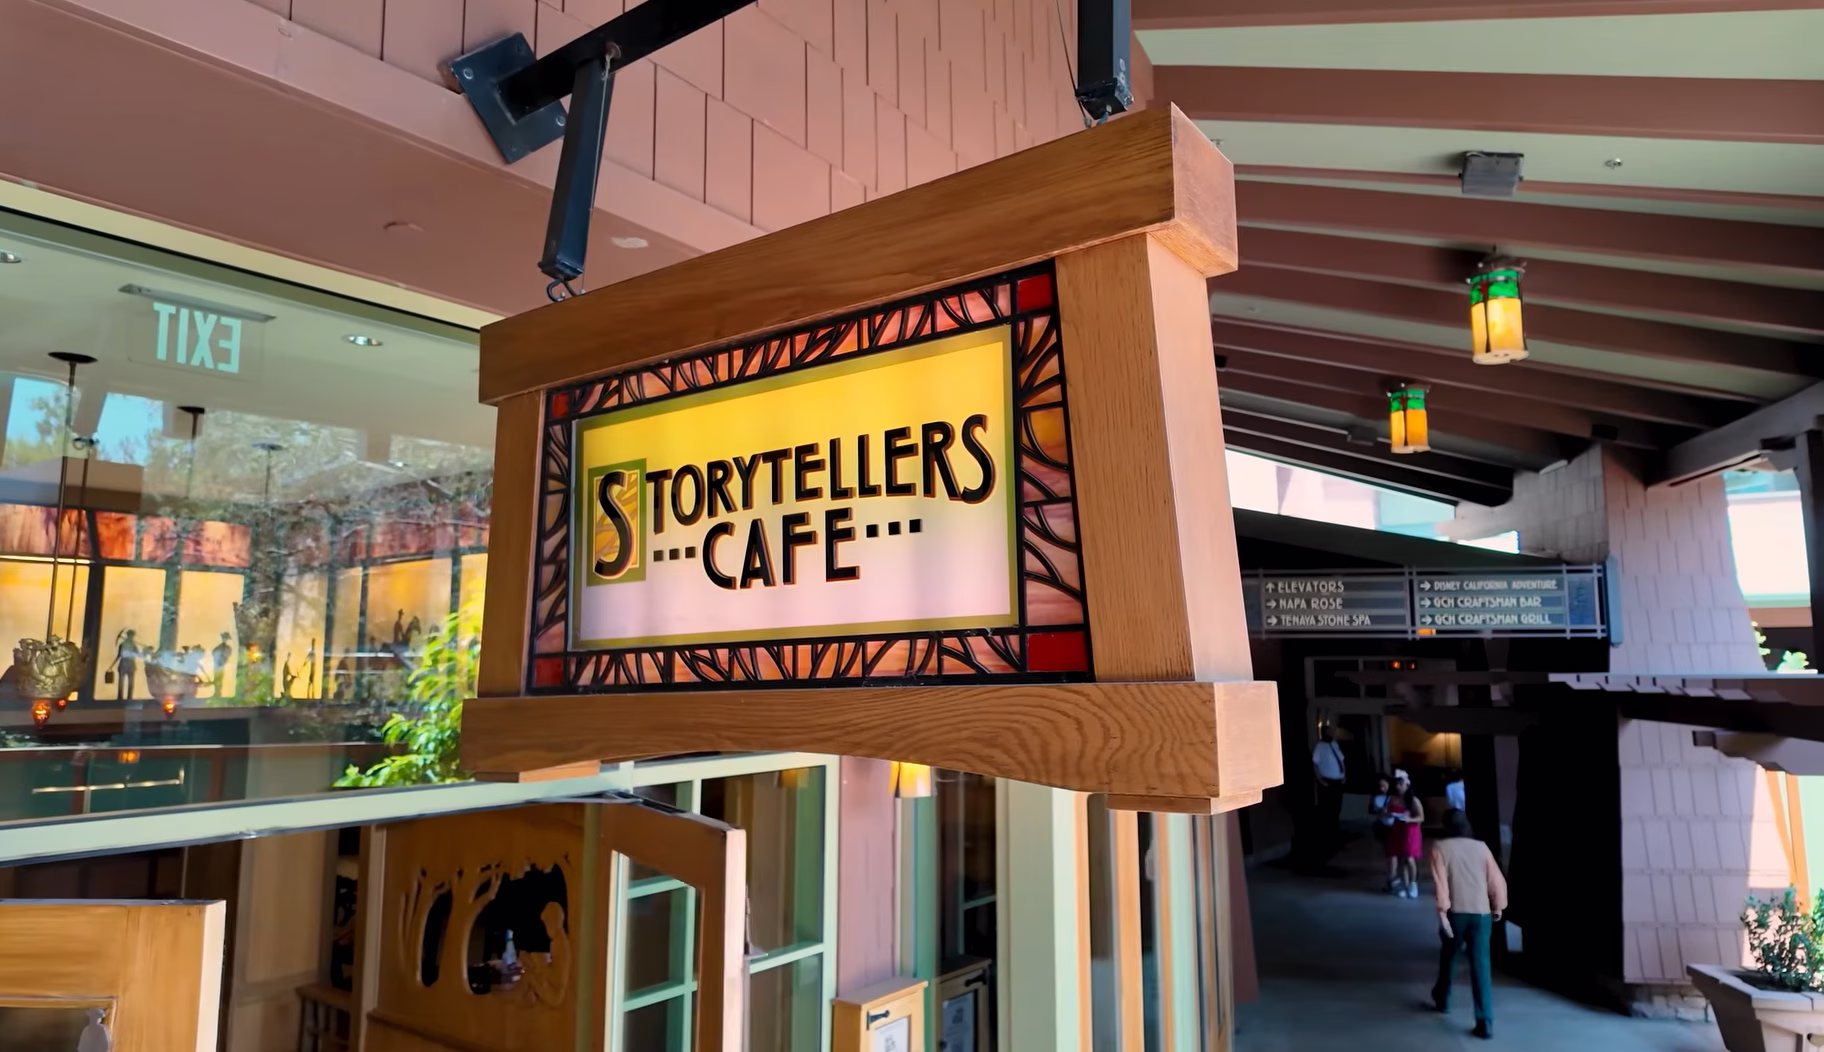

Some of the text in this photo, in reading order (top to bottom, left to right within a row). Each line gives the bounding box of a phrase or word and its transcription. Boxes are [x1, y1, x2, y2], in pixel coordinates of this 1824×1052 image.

[594, 414, 997, 578] STORYTELLERS
[702, 507, 860, 590] CAFE
[1277, 581, 1345, 594] ELEVATORS
[1434, 579, 1558, 591] DISNEY CALIFORNIA ADVENTURE
[1280, 597, 1343, 610] NAPA ROSE
[1433, 596, 1542, 608] GCH CRAFTSMAN BAR
[1281, 614, 1371, 627] TENAYA STONE SPA
[1434, 613, 1552, 626] GCH CRAFTSMAN GRILL
